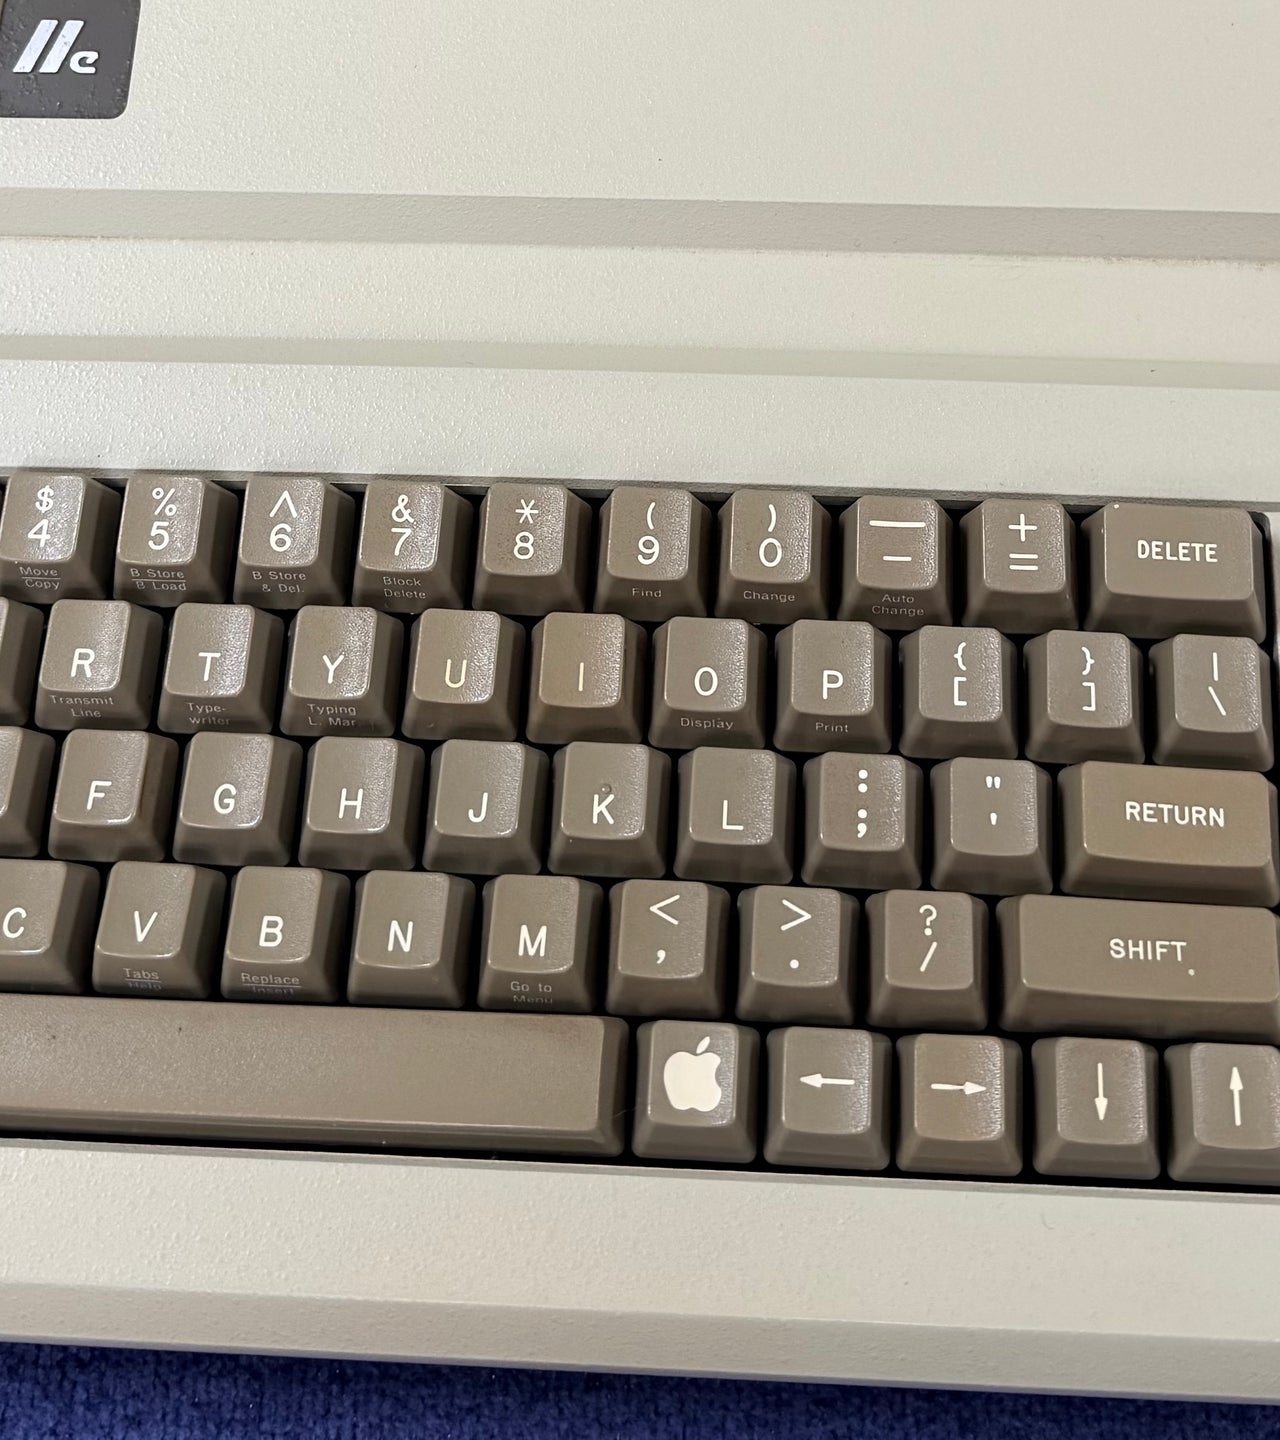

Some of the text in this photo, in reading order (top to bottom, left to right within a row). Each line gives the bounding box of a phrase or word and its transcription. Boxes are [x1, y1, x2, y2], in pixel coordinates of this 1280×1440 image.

[36, 486, 54, 511] $
[153, 487, 177, 517] %
[391, 494, 415, 523] &
[646, 501, 656, 530] (
[767, 503, 776, 532] )
[27, 520, 50, 547] 4
[147, 521, 169, 549] 5
[270, 523, 292, 552] 6
[391, 527, 411, 556] 7
[514, 531, 533, 560] 8
[637, 536, 659, 565] 9
[759, 538, 782, 568] 0
[1135, 538, 1218, 563] DELETE
[20, 567, 58, 577] Move
[25, 579, 60, 590] Copy
[131, 568, 185, 579] B Store
[136, 581, 186, 591] B Load
[252, 571, 306, 581] B Store
[383, 576, 421, 587] Block
[384, 589, 426, 599] Delete
[632, 588, 662, 598] Find
[744, 590, 796, 603] Change
[882, 593, 915, 604] Auto
[871, 605, 924, 617] Change
[71, 648, 96, 676] R
[198, 651, 222, 681] T
[322, 653, 345, 684] Y
[445, 657, 467, 689] U
[822, 669, 844, 700] P
[49, 694, 114, 707] Transmit
[71, 708, 102, 719] Line
[188, 702, 226, 715] Type-
[307, 703, 356, 717] Typing
[189, 715, 231, 726] writer
[680, 716, 733, 732] Display
[815, 721, 849, 734] Print
[86, 779, 111, 810] F
[213, 783, 236, 814] G
[340, 788, 363, 820] H
[468, 792, 489, 823] J
[592, 794, 614, 825] K
[722, 798, 743, 830] L
[1125, 800, 1225, 828] RETURN
[1, 907, 26, 938] C
[133, 910, 157, 943] V
[259, 915, 284, 947] B
[919, 905, 936, 936] ?
[387, 920, 413, 953] N
[518, 925, 546, 958] M
[1108, 938, 1187, 962] SHIFT
[123, 968, 159, 980] Tabs
[241, 973, 300, 986] Replace
[511, 981, 552, 993] Go to
